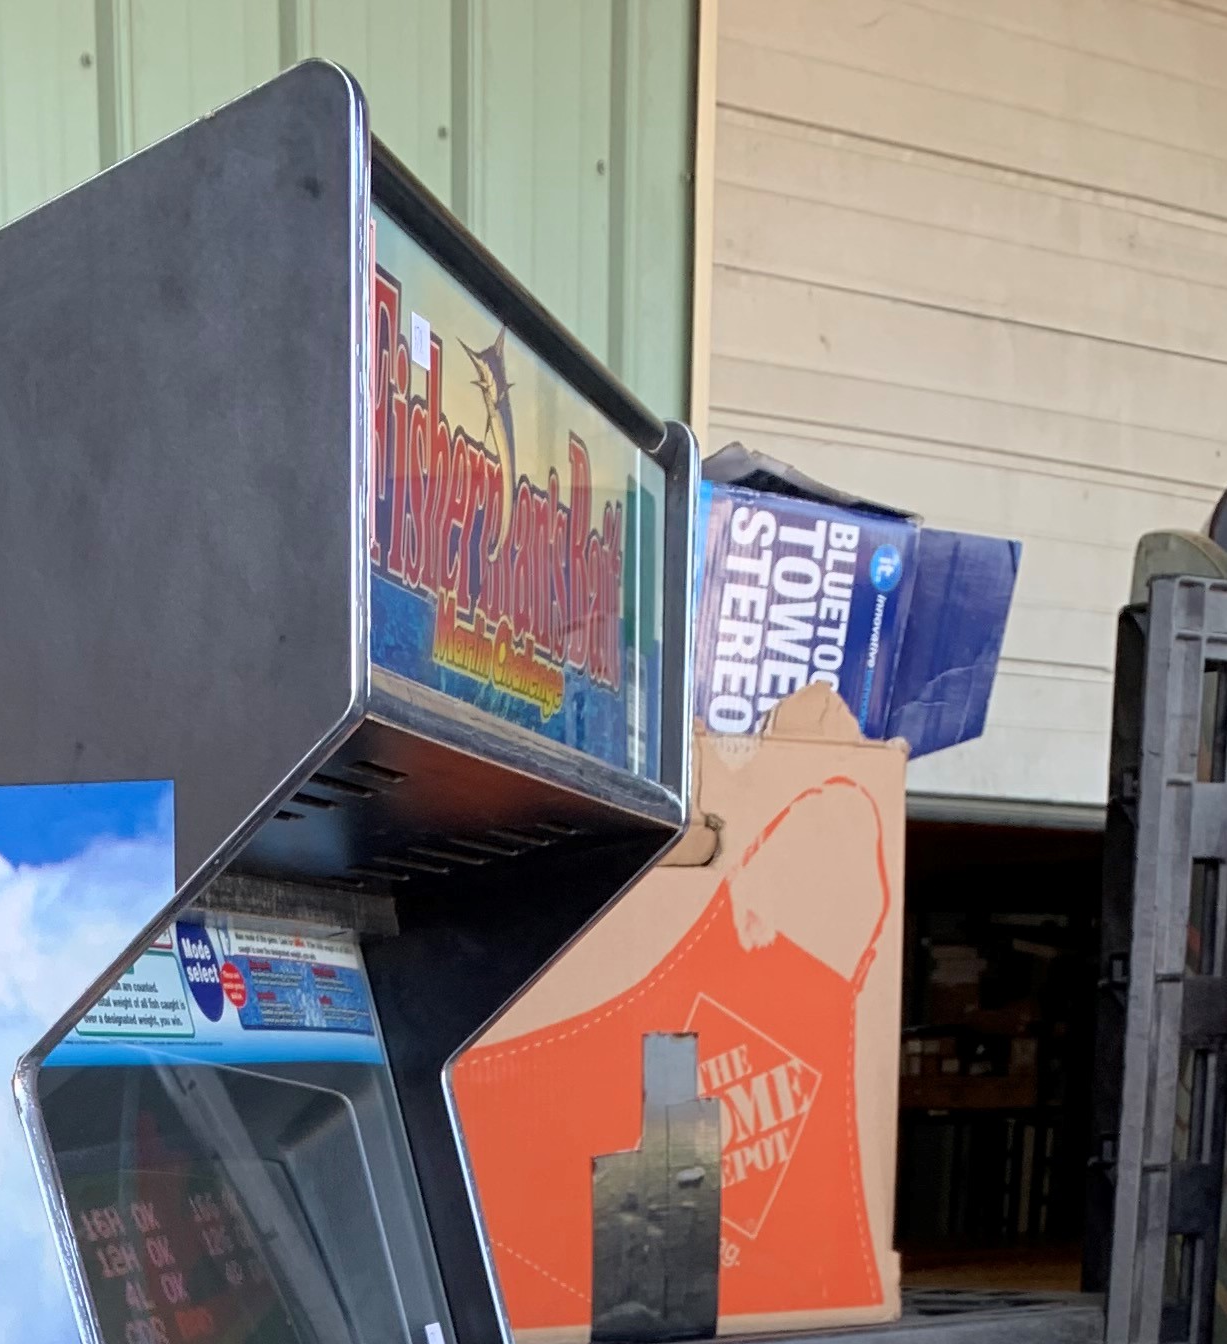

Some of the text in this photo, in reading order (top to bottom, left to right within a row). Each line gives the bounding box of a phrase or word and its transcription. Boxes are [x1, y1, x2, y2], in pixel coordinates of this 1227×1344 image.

[568, 432, 623, 692] Bait
[708, 506, 777, 735] STEREO
[810, 521, 861, 693] BLUETOO
[433, 588, 565, 722] Marlin Challenge
[181, 937, 212, 960] Mode
[186, 962, 220, 984] select
[113, 997, 133, 1010] weight
[133, 997, 141, 1008] of
[148, 998, 161, 1010] fish
[160, 998, 181, 1012] caught
[122, 982, 133, 992] are
[133, 981, 159, 993] counted.
[104, 1012, 137, 1027] designated
[160, 1016, 171, 1028] you
[697, 1043, 752, 1097] THE
[720, 1126, 790, 1189] EPOT
